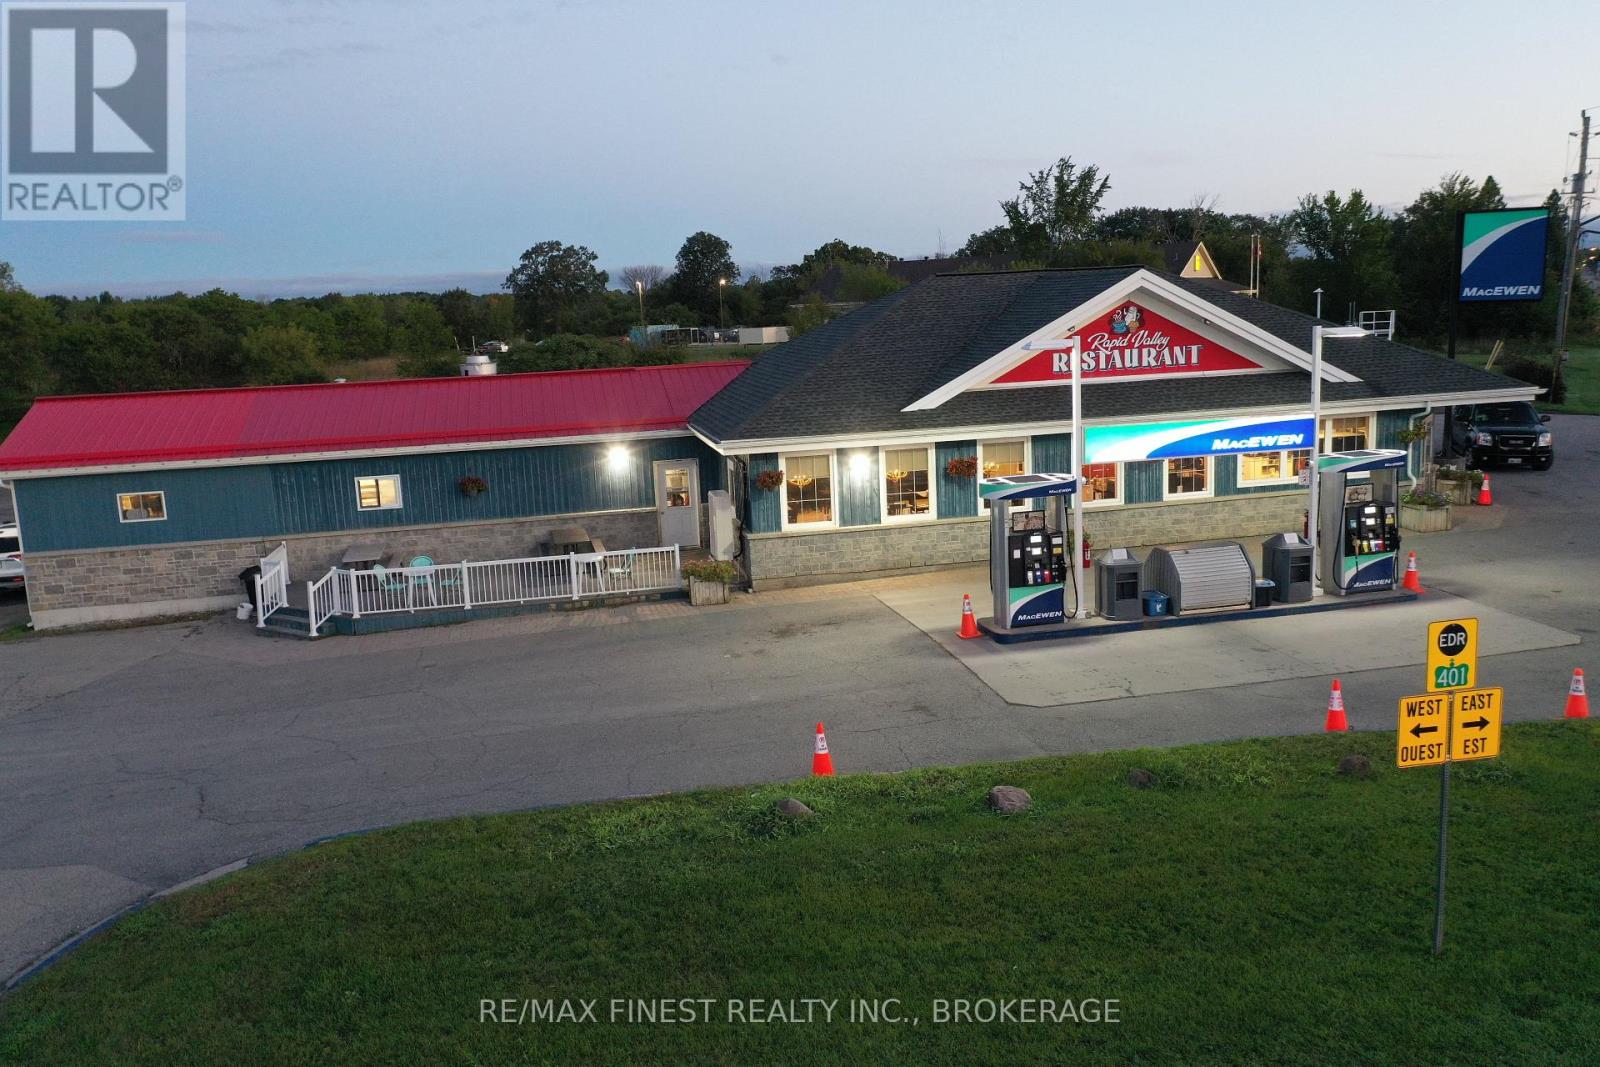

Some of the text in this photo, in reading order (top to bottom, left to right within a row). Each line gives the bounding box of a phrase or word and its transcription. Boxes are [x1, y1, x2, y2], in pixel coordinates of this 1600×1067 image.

[1088, 330, 1170, 354] Rapid Valley
[1052, 345, 1203, 372] RSTAURANT
[1439, 632, 1466, 648] EDR
[1437, 667, 1465, 687] 401
[1406, 699, 1443, 718] WEST
[1461, 693, 1494, 711] EAST
[1401, 743, 1443, 762] OUEST
[1463, 737, 1487, 755] EST
